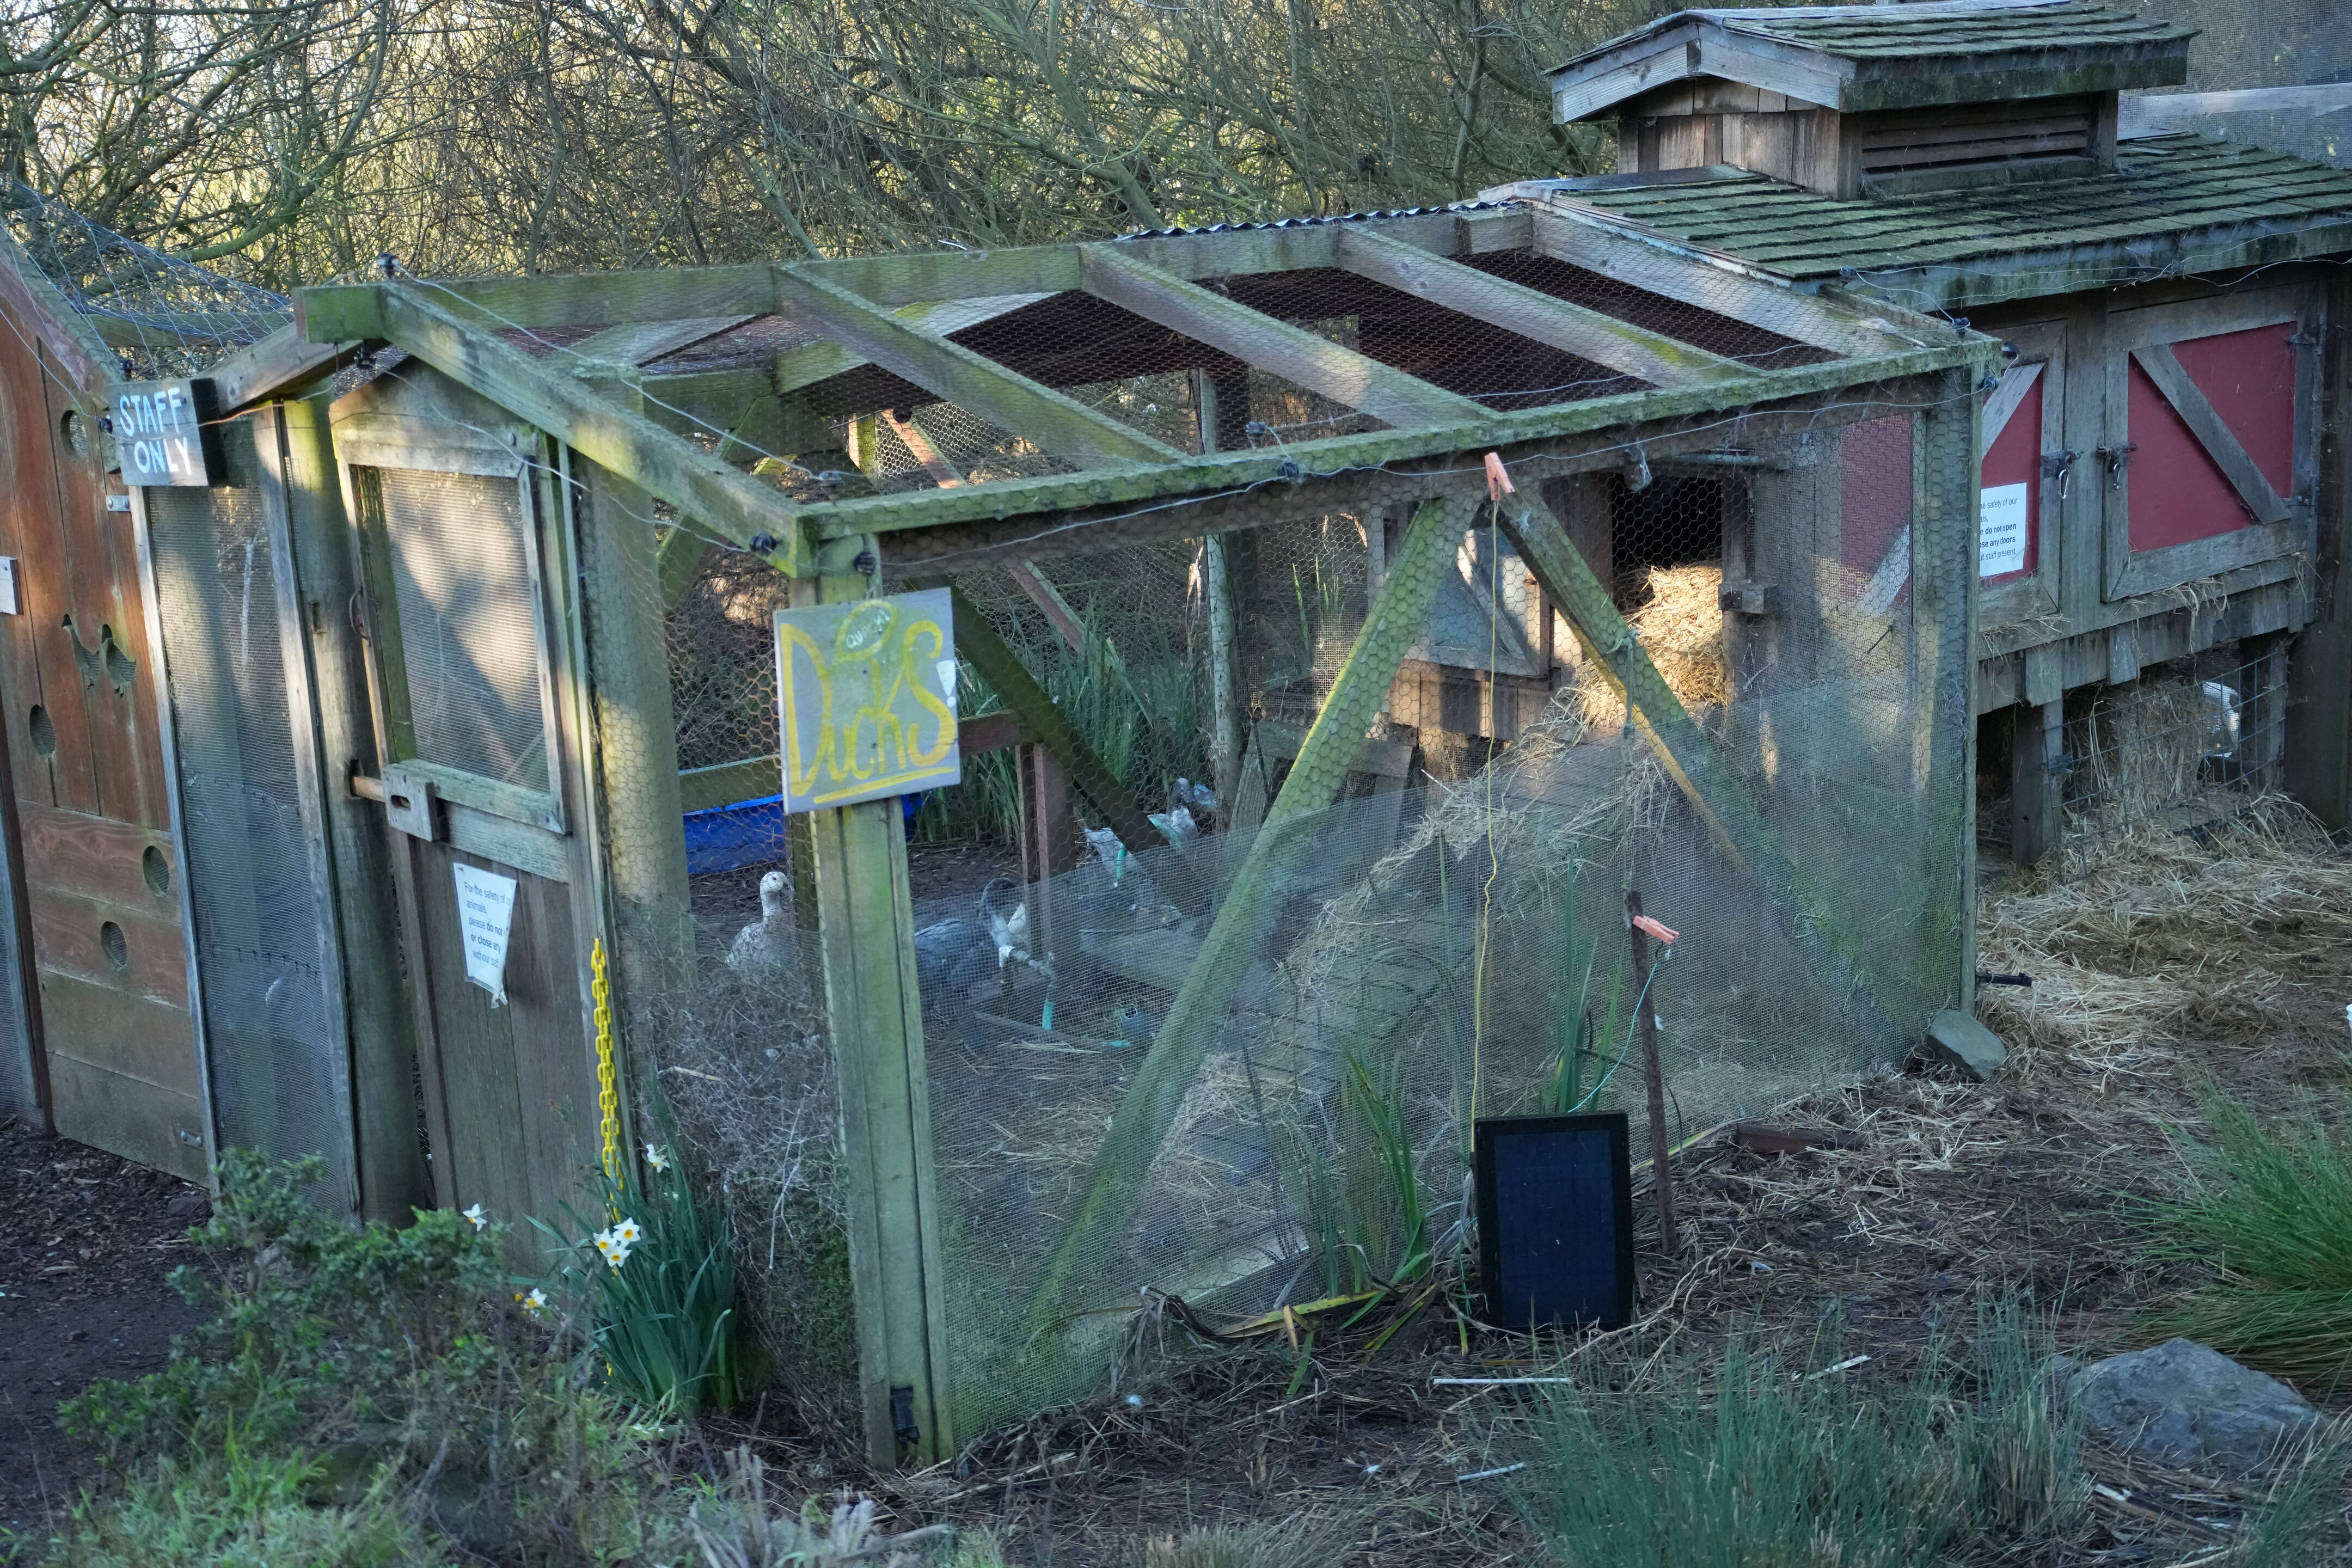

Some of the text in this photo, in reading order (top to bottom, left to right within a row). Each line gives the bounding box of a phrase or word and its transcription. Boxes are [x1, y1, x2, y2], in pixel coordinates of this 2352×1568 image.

[119, 387, 182, 436] STAFF
[134, 437, 192, 476] ONLY
[1987, 500, 2002, 509] safety
[2003, 498, 2007, 506] of
[1985, 526, 1993, 535] do
[2002, 523, 2016, 533] open
[1990, 539, 2000, 548] any
[2000, 536, 2016, 545] doors
[1986, 550, 1996, 560] staff
[464, 881, 474, 893] For
[486, 920, 494, 933] do
[494, 926, 503, 936] not
[470, 934, 476, 942] or
[477, 935, 492, 948] close
